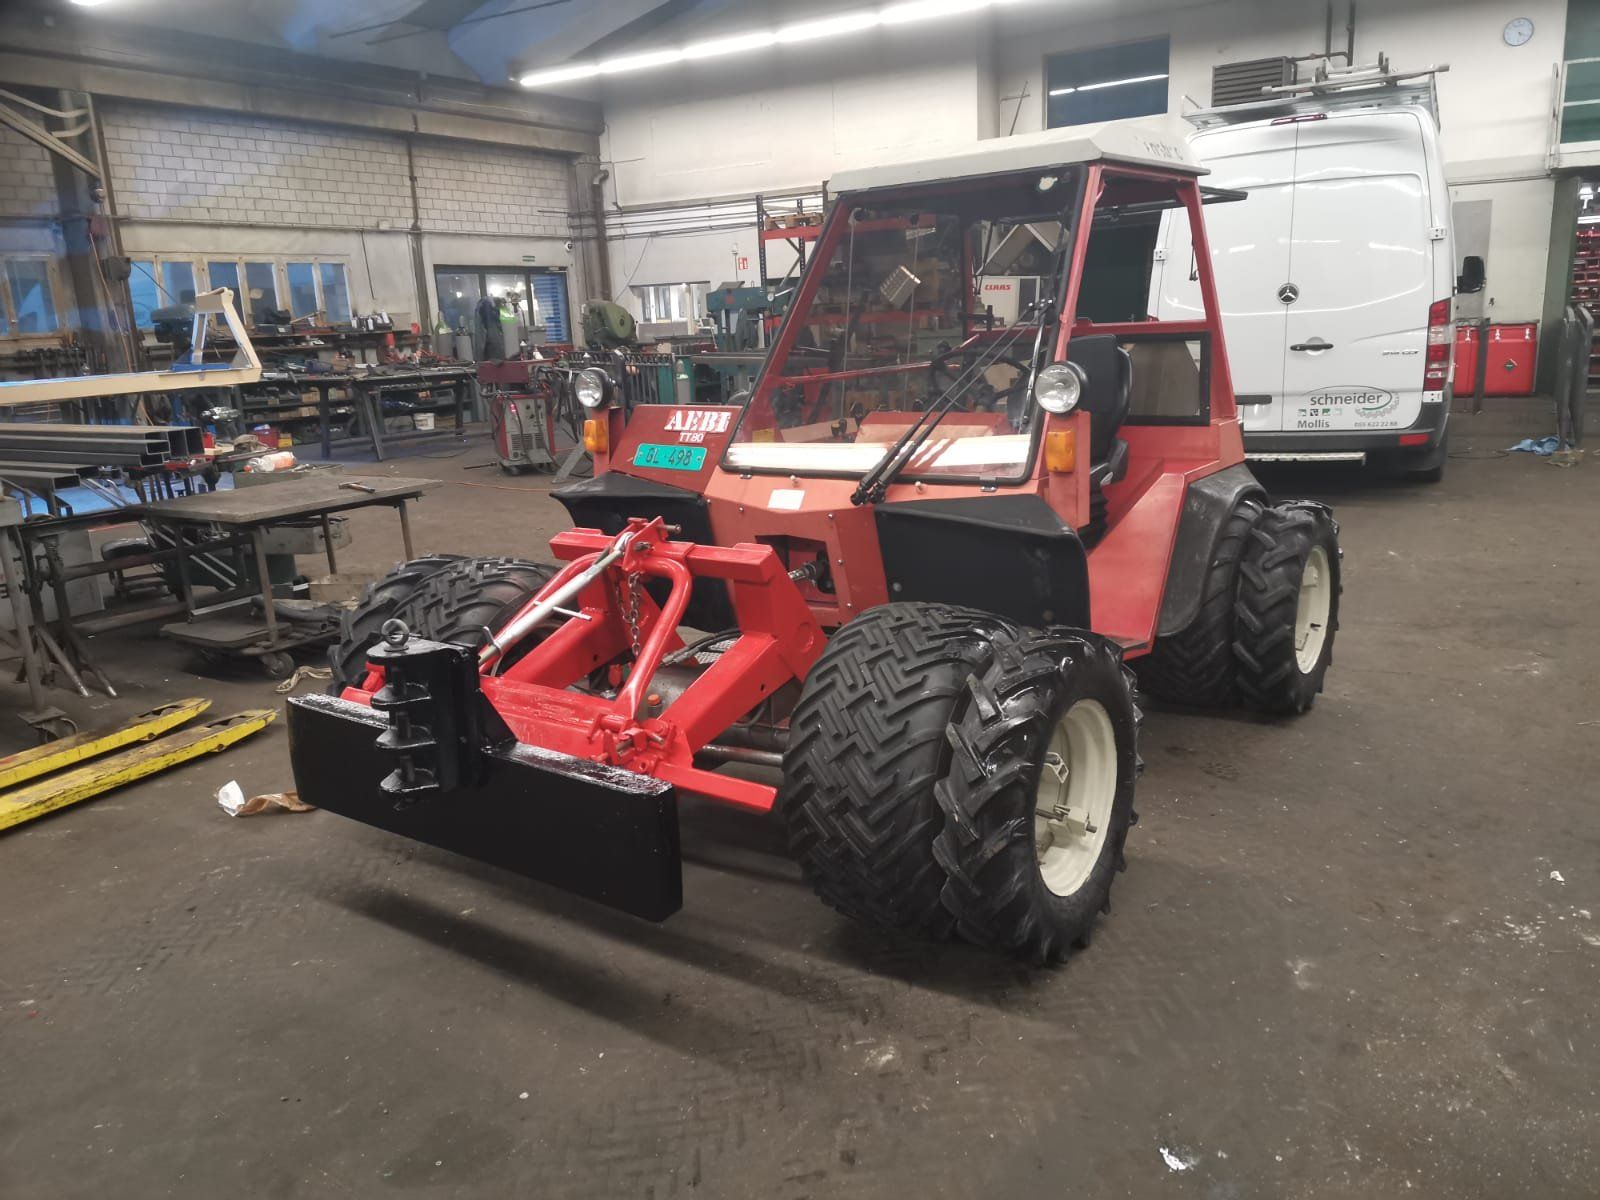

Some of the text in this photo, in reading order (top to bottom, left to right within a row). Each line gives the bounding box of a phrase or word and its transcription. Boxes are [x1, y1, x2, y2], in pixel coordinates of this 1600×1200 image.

[1310, 392, 1383, 406] schneider
[664, 410, 732, 433] AEBI
[1297, 419, 1330, 429] Mollis
[679, 432, 705, 443] TT80
[645, 447, 693, 466] GL 498
